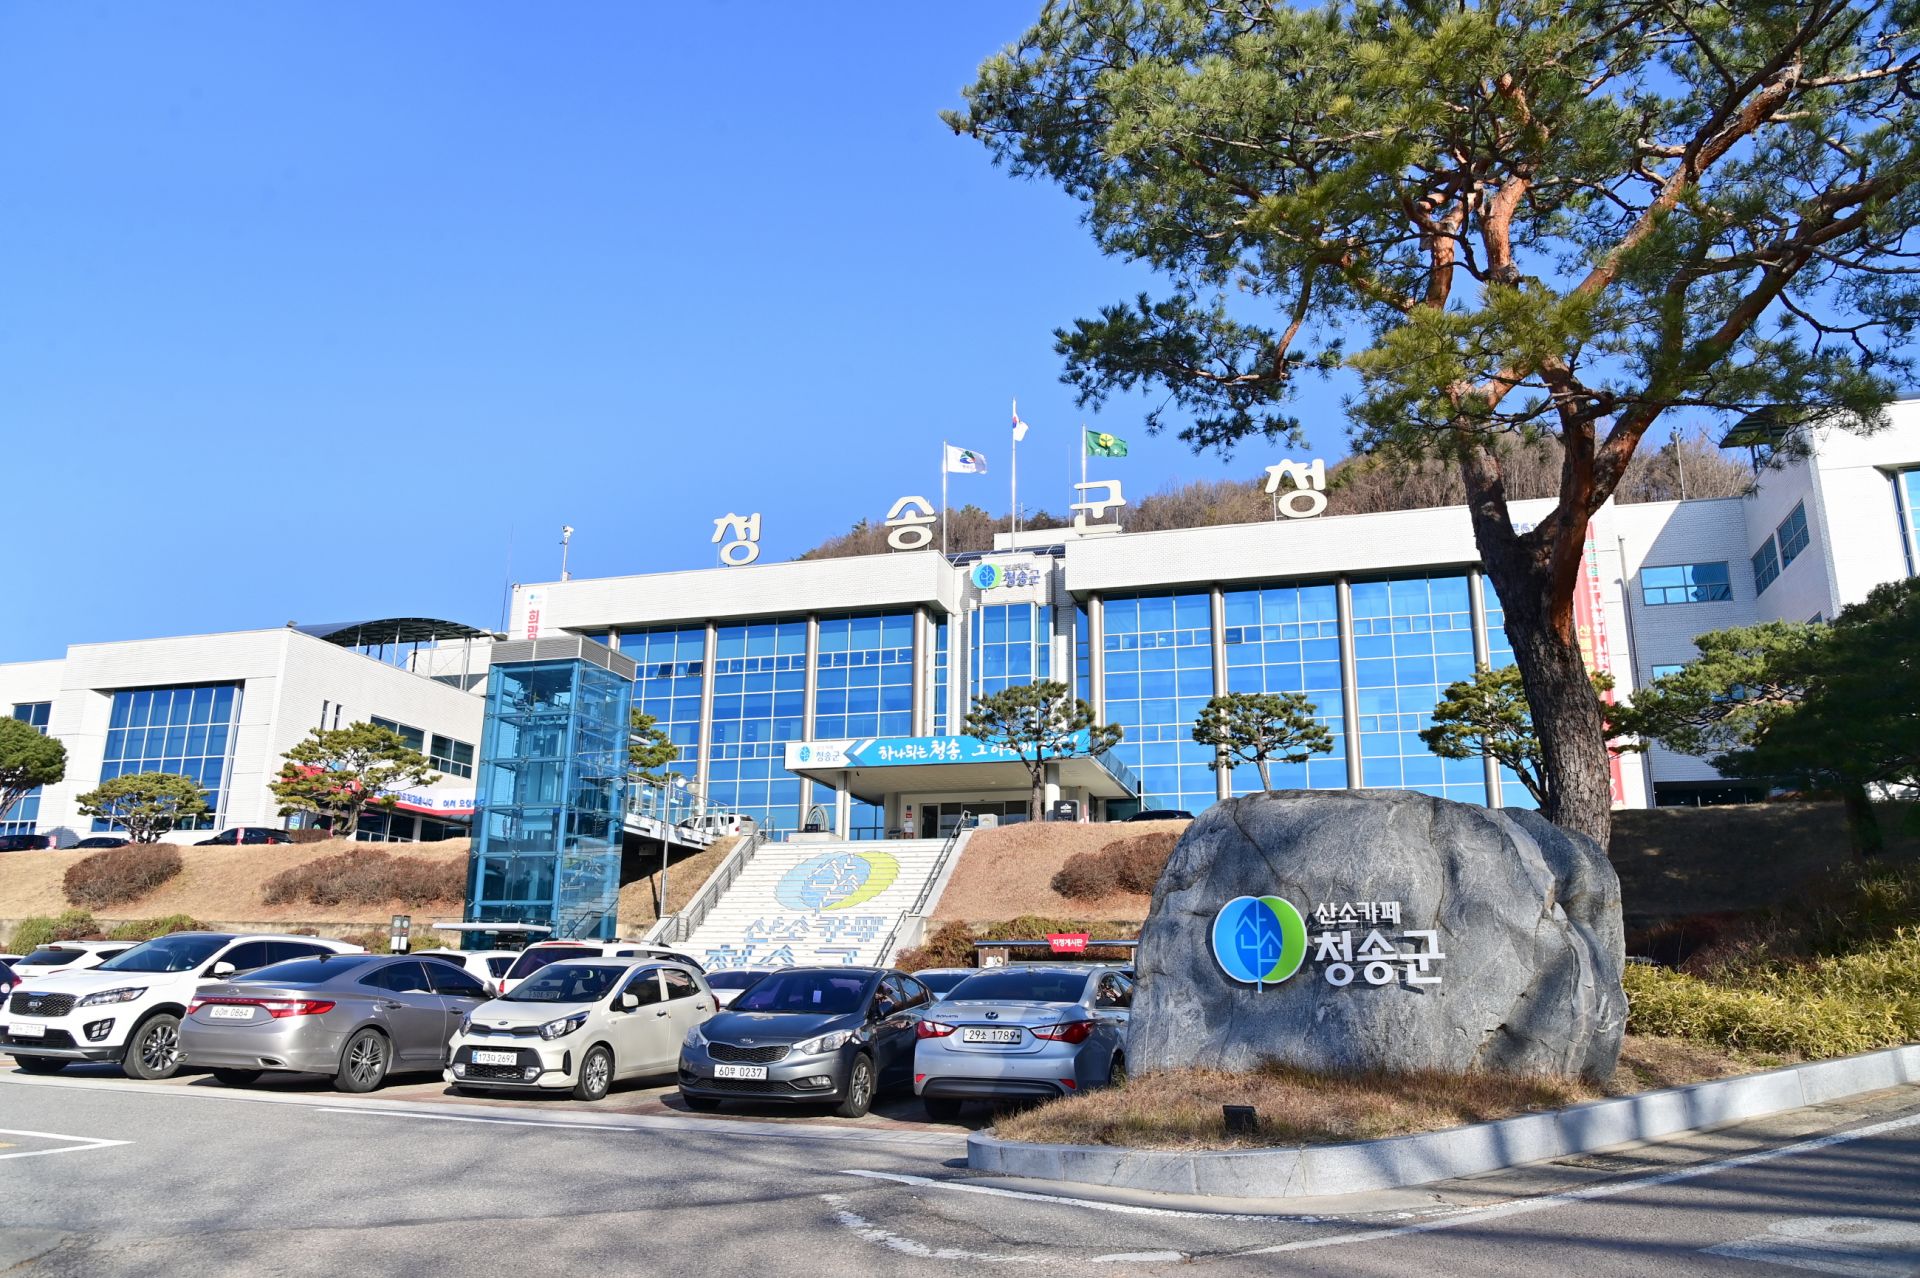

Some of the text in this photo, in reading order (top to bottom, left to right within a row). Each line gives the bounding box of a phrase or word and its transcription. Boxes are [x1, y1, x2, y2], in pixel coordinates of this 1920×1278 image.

[1003, 570, 1041, 587] 청송군
[816, 751, 840, 762] 청송군
[878, 745, 928, 761] 하나되는
[971, 744, 988, 757] 그
[1315, 901, 1401, 925] 산소카페
[1313, 929, 1446, 987] 청송군
[968, 1029, 1016, 1040] 29소 1789
[497, 1054, 515, 1063] 2692
[739, 1067, 763, 1077] 0237
